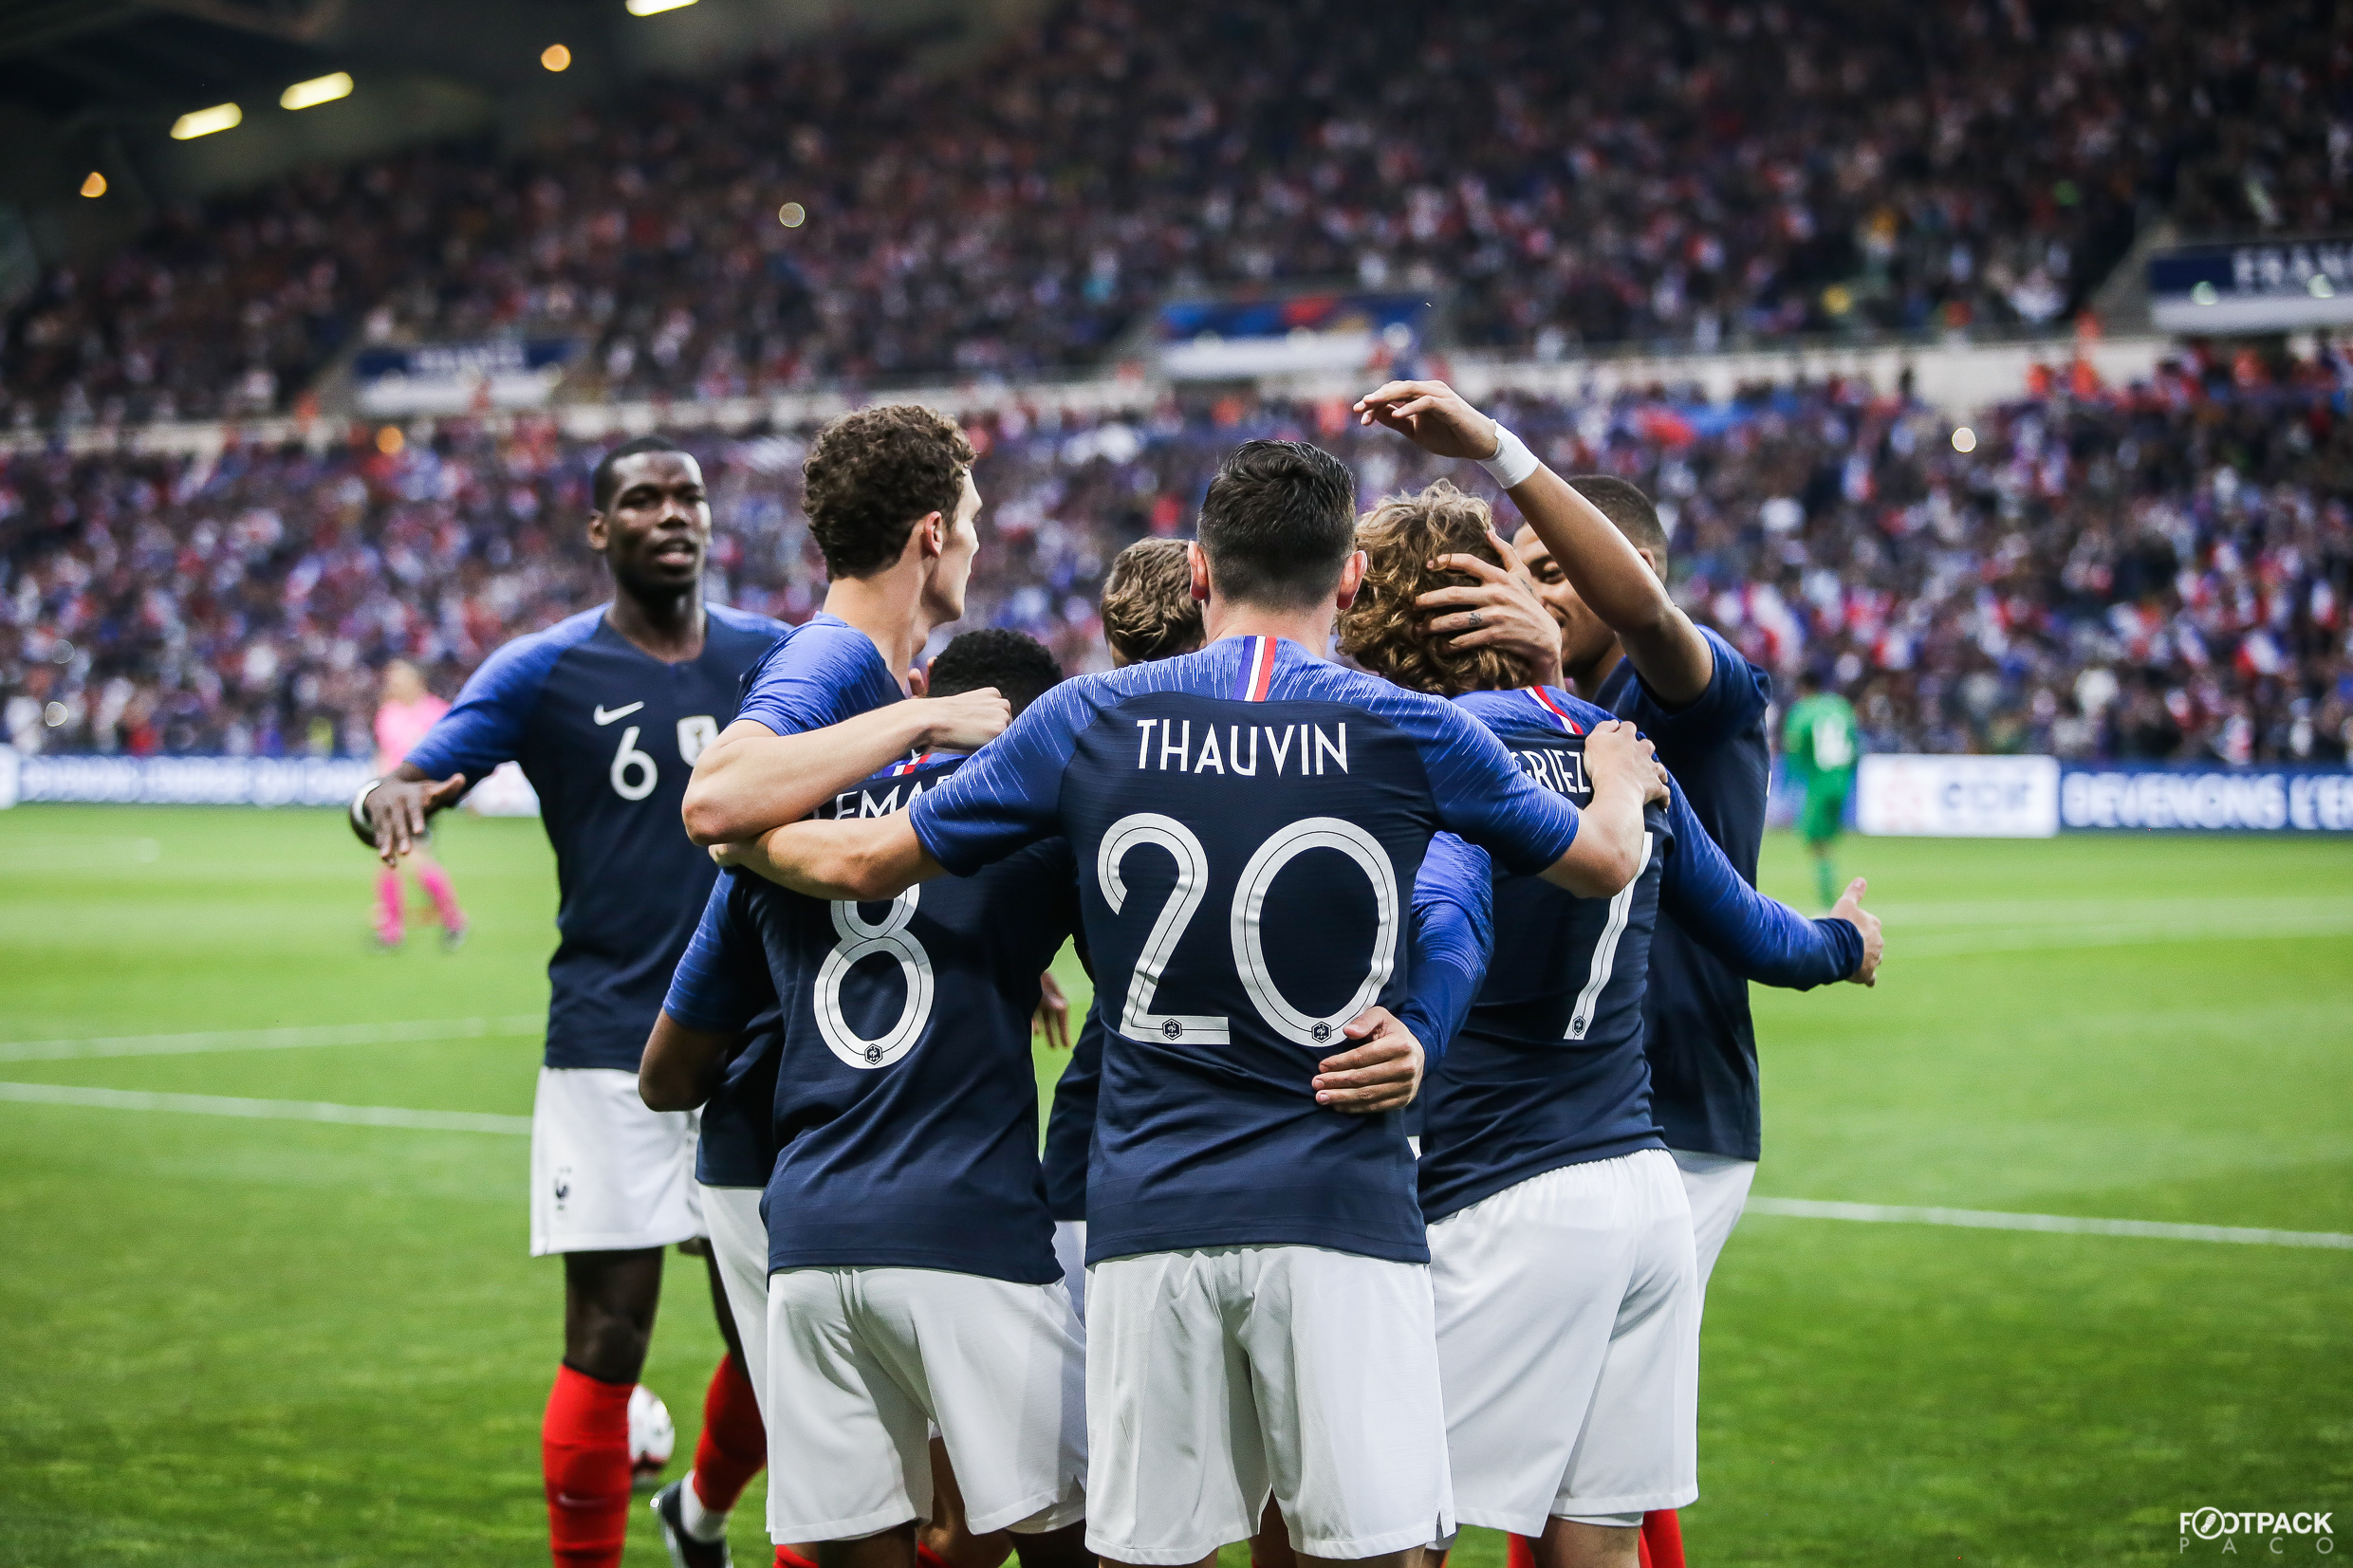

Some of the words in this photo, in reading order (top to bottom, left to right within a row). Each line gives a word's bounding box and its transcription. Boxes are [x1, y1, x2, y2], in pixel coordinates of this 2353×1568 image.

[611, 726, 658, 801] 6
[1136, 718, 1349, 776] THAUVIN
[813, 882, 935, 1069] 8
[1097, 813, 1399, 1047] 20
